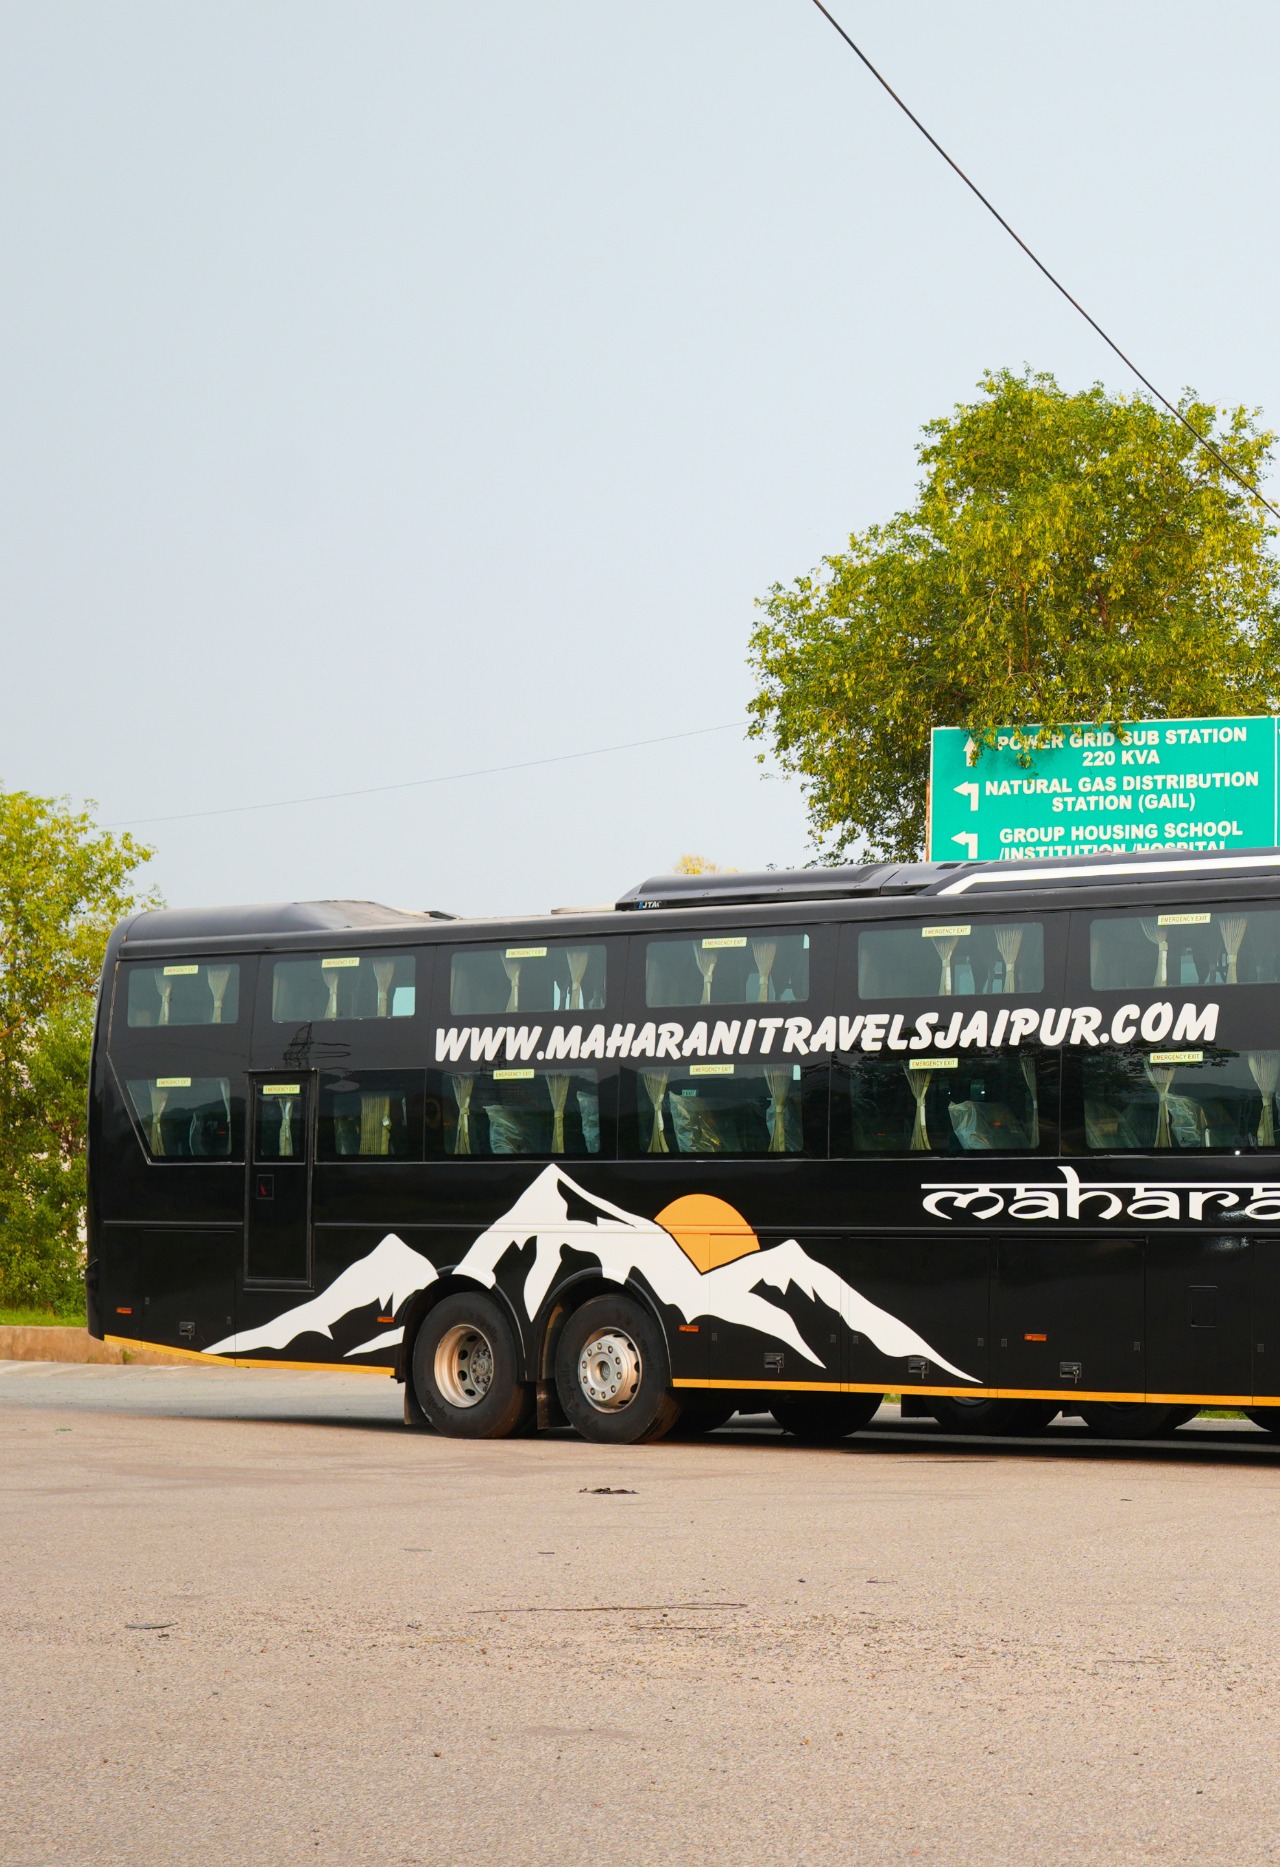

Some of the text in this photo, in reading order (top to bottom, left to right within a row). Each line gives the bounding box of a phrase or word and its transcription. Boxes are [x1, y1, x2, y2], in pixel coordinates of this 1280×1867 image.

[1069, 732, 1115, 748] GRID
[1121, 730, 1160, 747] SUB
[1165, 726, 1248, 745] STATION
[1082, 749, 1160, 767] 220 KVA
[985, 771, 1259, 796] NATURAL GAS DISTRIBUTION
[1052, 792, 1196, 813] STATION (GAIL)
[999, 820, 1243, 844] GROUP HOUSING SCHOOL
[1160, 915, 1195, 923] EMERGENCY
[435, 1001, 1220, 1063] WWW.MAHARANITRAVELSJAIPUR.COM
[912, 1060, 943, 1068] EMERGENCY
[1152, 1053, 1187, 1061] EMERGENCY
